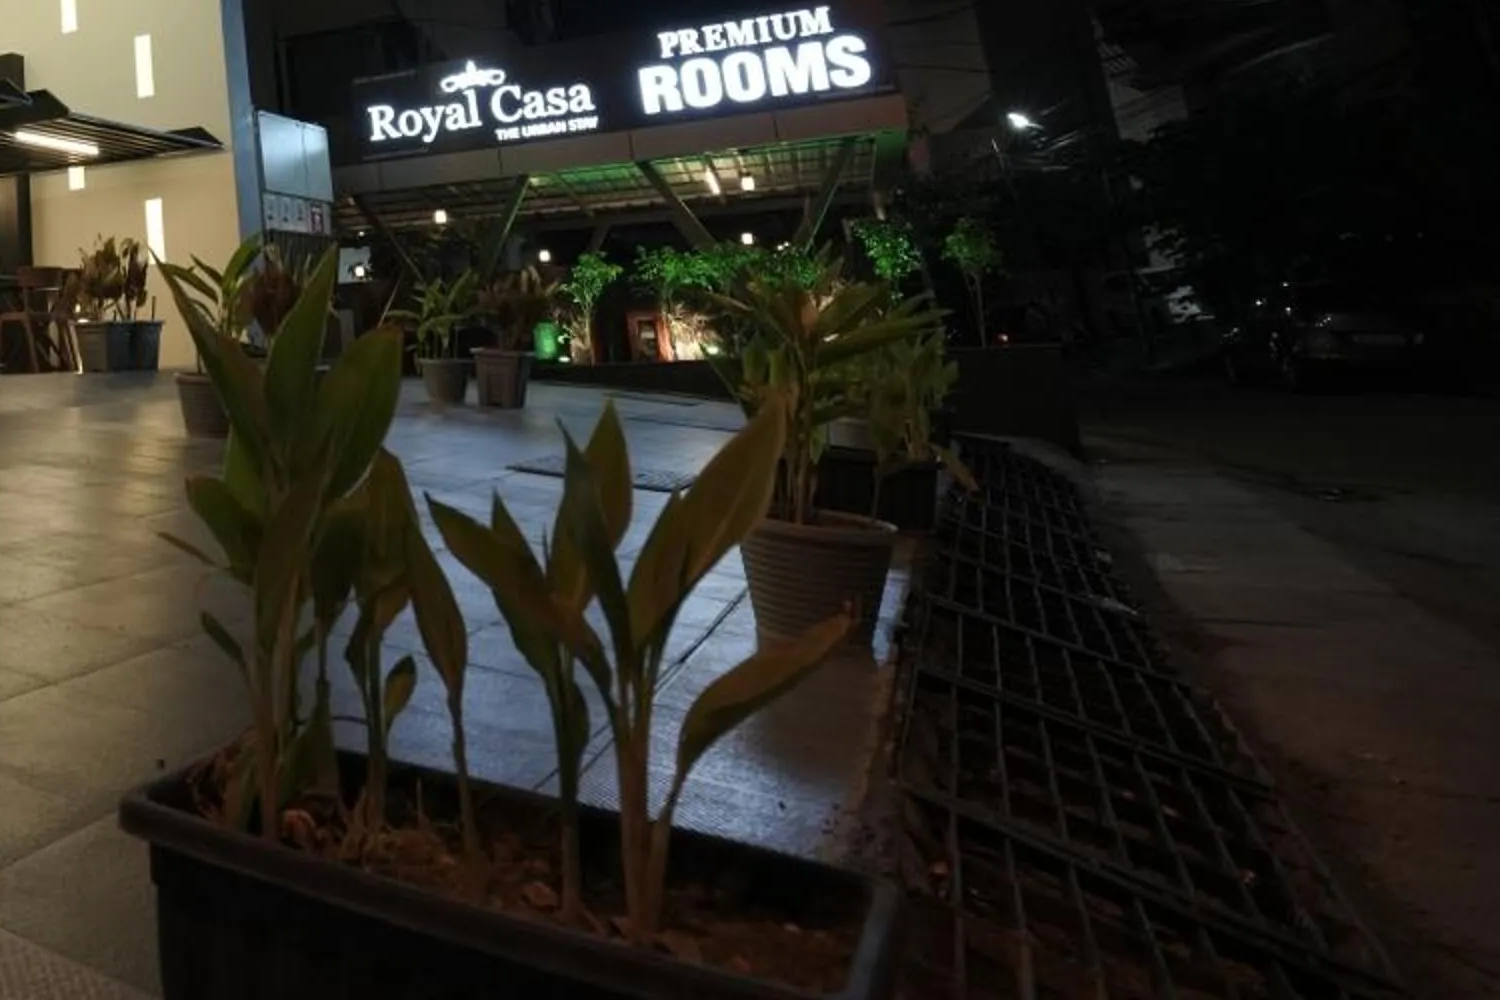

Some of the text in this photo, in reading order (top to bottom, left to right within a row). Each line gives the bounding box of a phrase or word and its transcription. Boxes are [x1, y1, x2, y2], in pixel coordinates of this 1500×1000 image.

[657, 5, 834, 59] PREMIUM
[638, 34, 871, 115] ROOMS
[367, 83, 596, 143] Royal Casa
[494, 115, 598, 141] THE URBAN STAY
